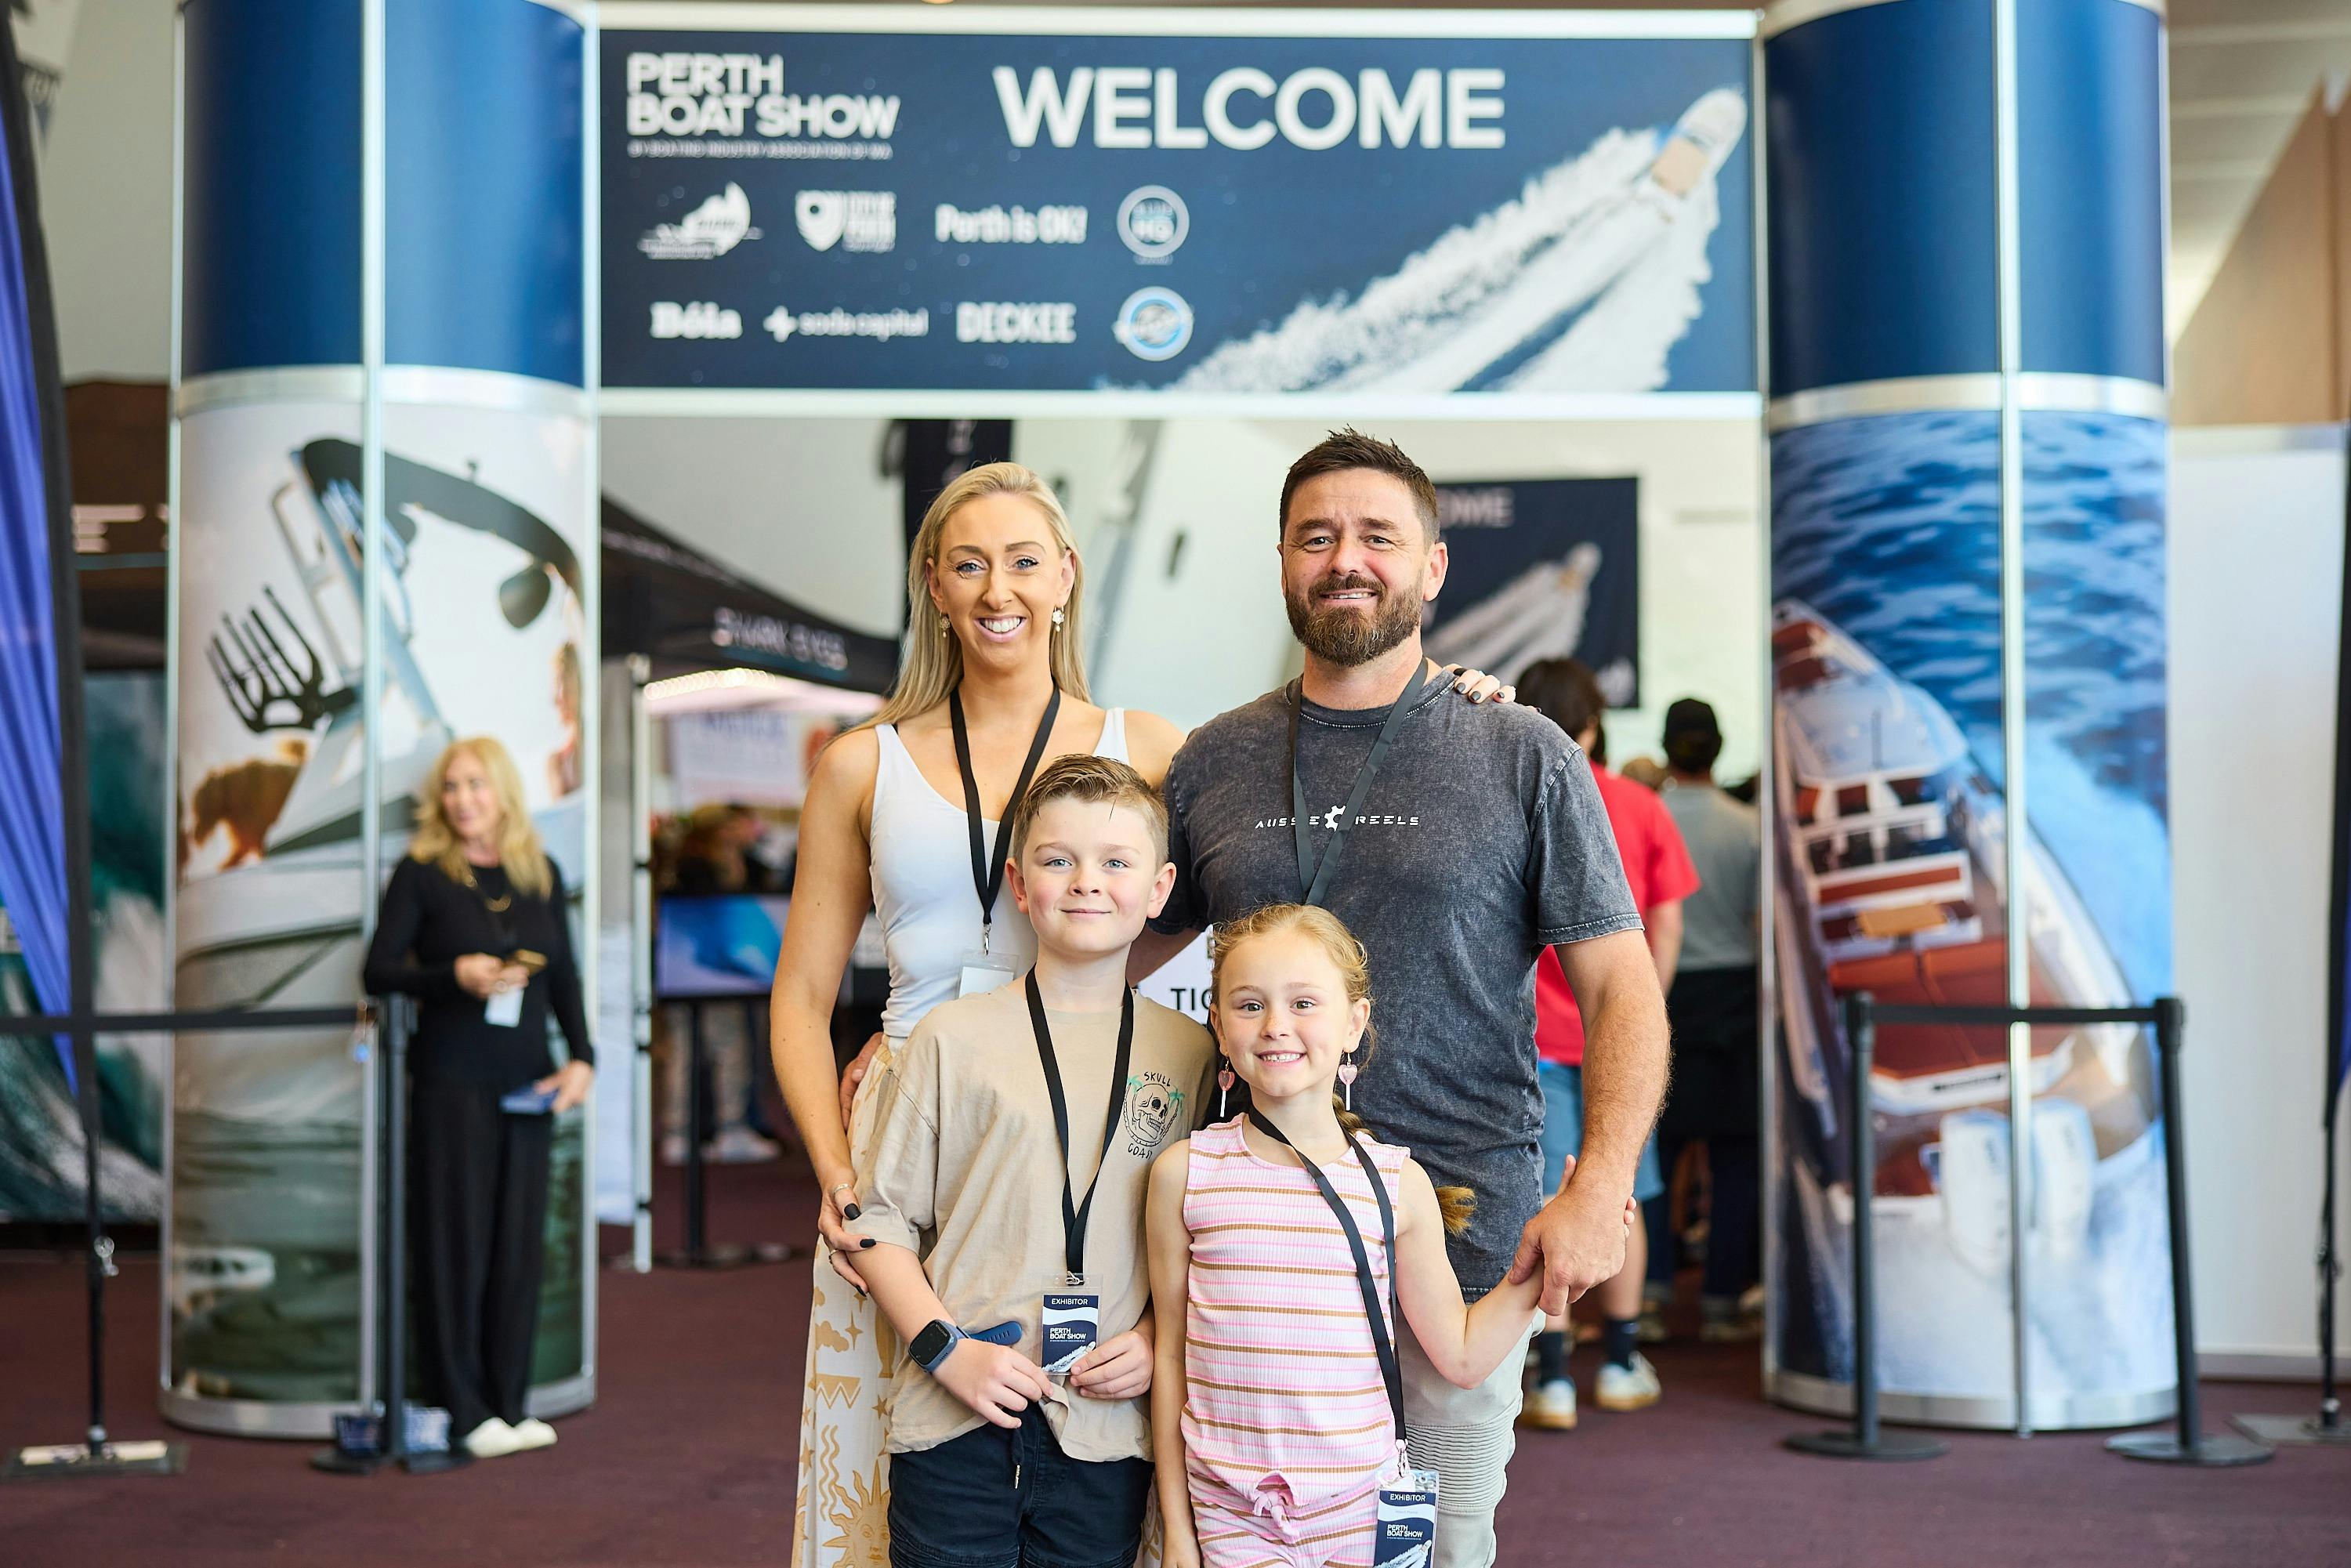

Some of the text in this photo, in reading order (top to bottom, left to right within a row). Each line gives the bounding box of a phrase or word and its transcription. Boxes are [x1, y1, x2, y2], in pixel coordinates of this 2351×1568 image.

[628, 53, 783, 96] PERTH
[628, 92, 900, 139] BOAT SHOW
[993, 66, 1505, 150] WELCOME
[936, 204, 1010, 244] Perth
[1255, 815, 1419, 829] AUSSE REELS
[1144, 1071, 1170, 1086] SKULL
